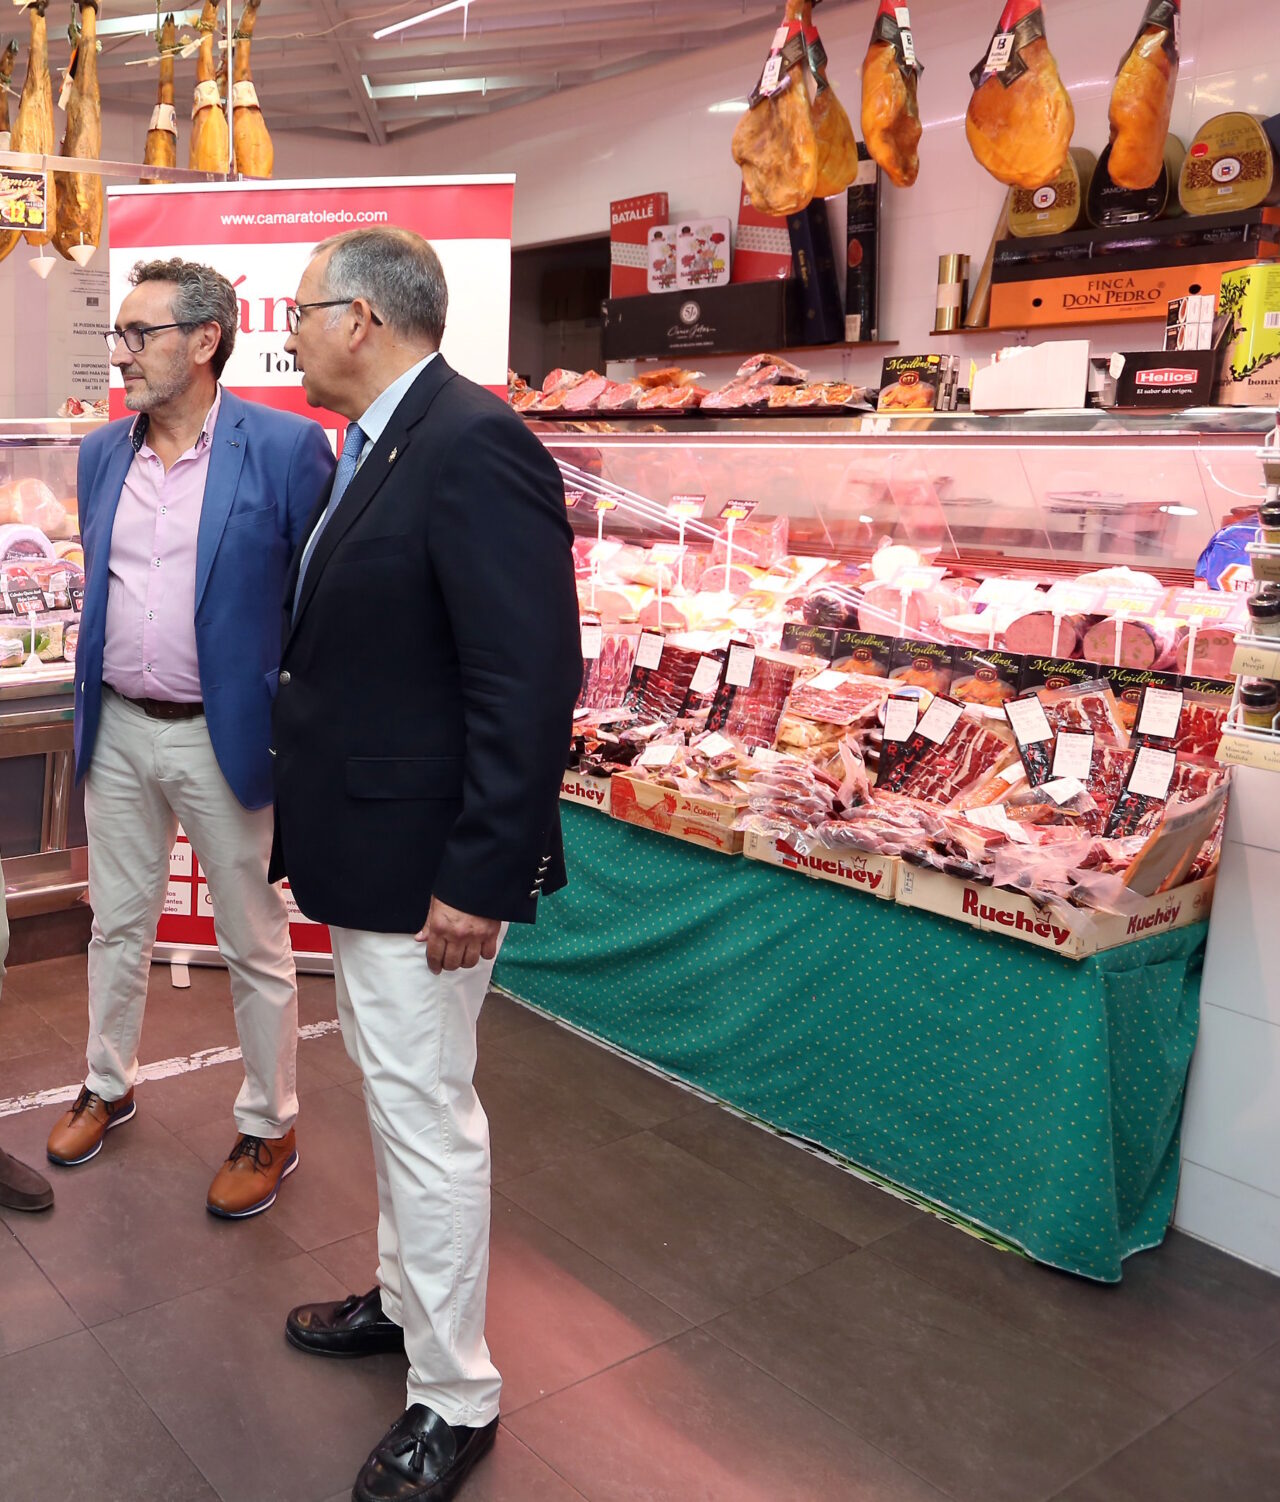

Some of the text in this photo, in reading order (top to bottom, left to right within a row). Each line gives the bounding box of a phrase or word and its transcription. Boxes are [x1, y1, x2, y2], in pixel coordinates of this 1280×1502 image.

[221, 209, 388, 225] www.camaratoledo.com
[1088, 278, 1135, 291] FINCA
[1063, 287, 1162, 307] DON PEDRO
[1140, 372, 1193, 383] Helios
[786, 625, 826, 644] Mejillones
[840, 632, 884, 649] Mejillones
[899, 641, 945, 659] Mejillones
[961, 650, 1012, 669] Mejillones
[1029, 659, 1086, 677] Mejillones
[1103, 668, 1166, 687] Mejillones
[961, 887, 1071, 945] Ruchey
